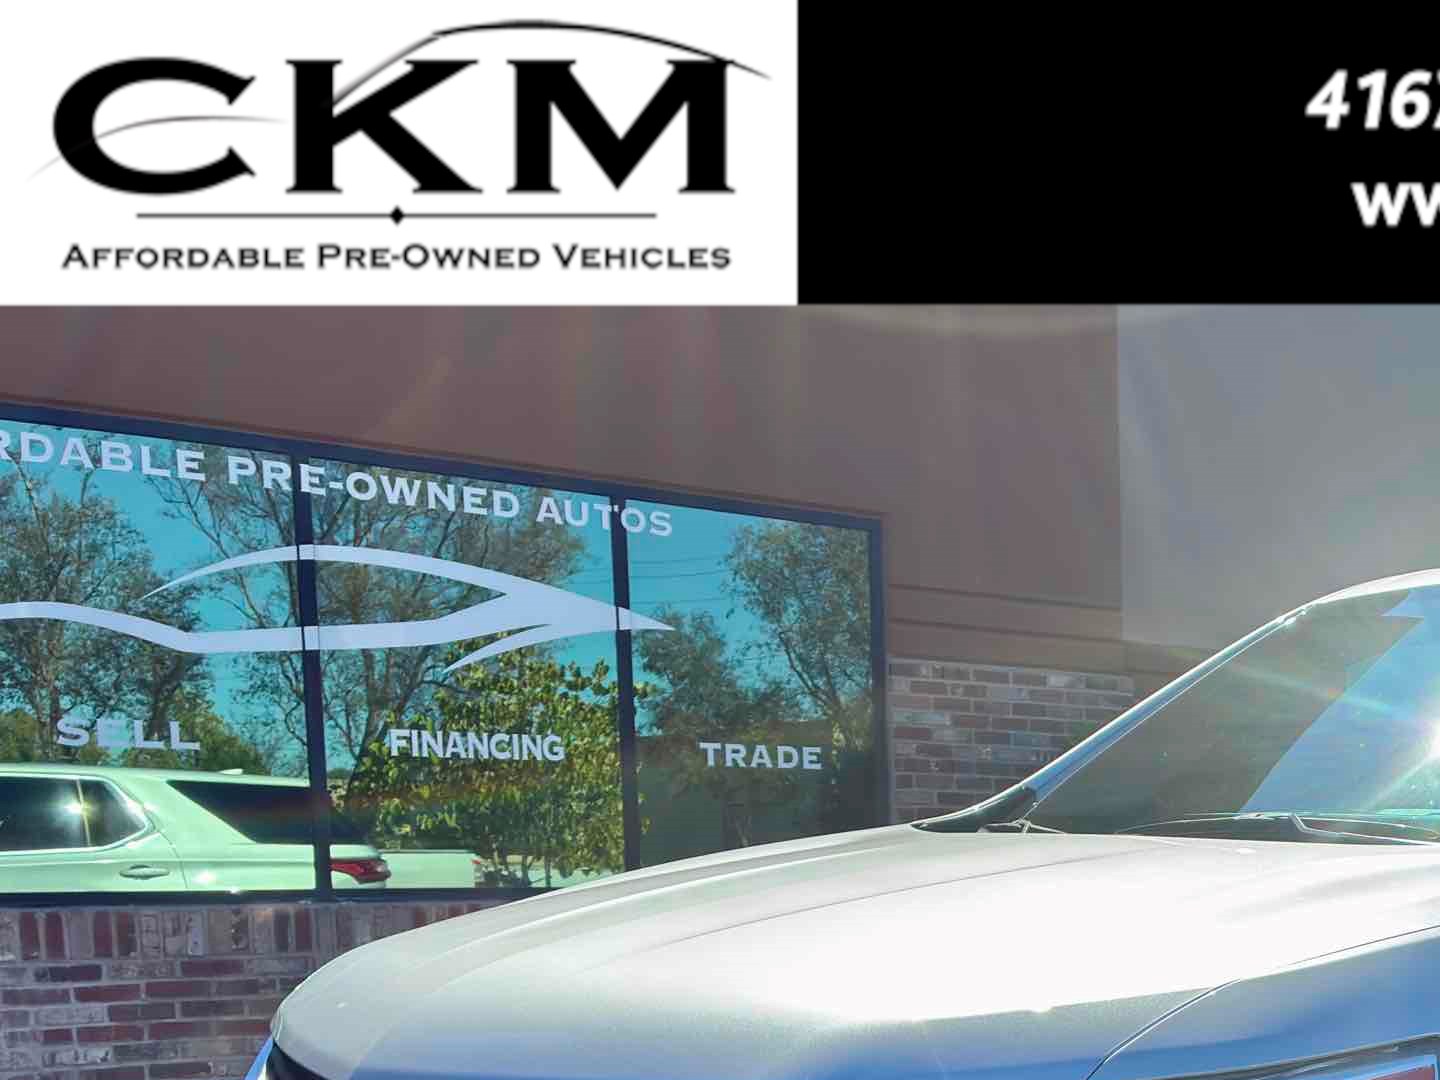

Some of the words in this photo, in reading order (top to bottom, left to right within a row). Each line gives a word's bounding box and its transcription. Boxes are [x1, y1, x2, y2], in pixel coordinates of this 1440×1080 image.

[227, 456, 520, 518] PRE-OWNED
[536, 496, 673, 538] AUTOS
[56, 716, 201, 750] SELL
[389, 728, 566, 762] FINANCING
[700, 741, 823, 771] TRADE
